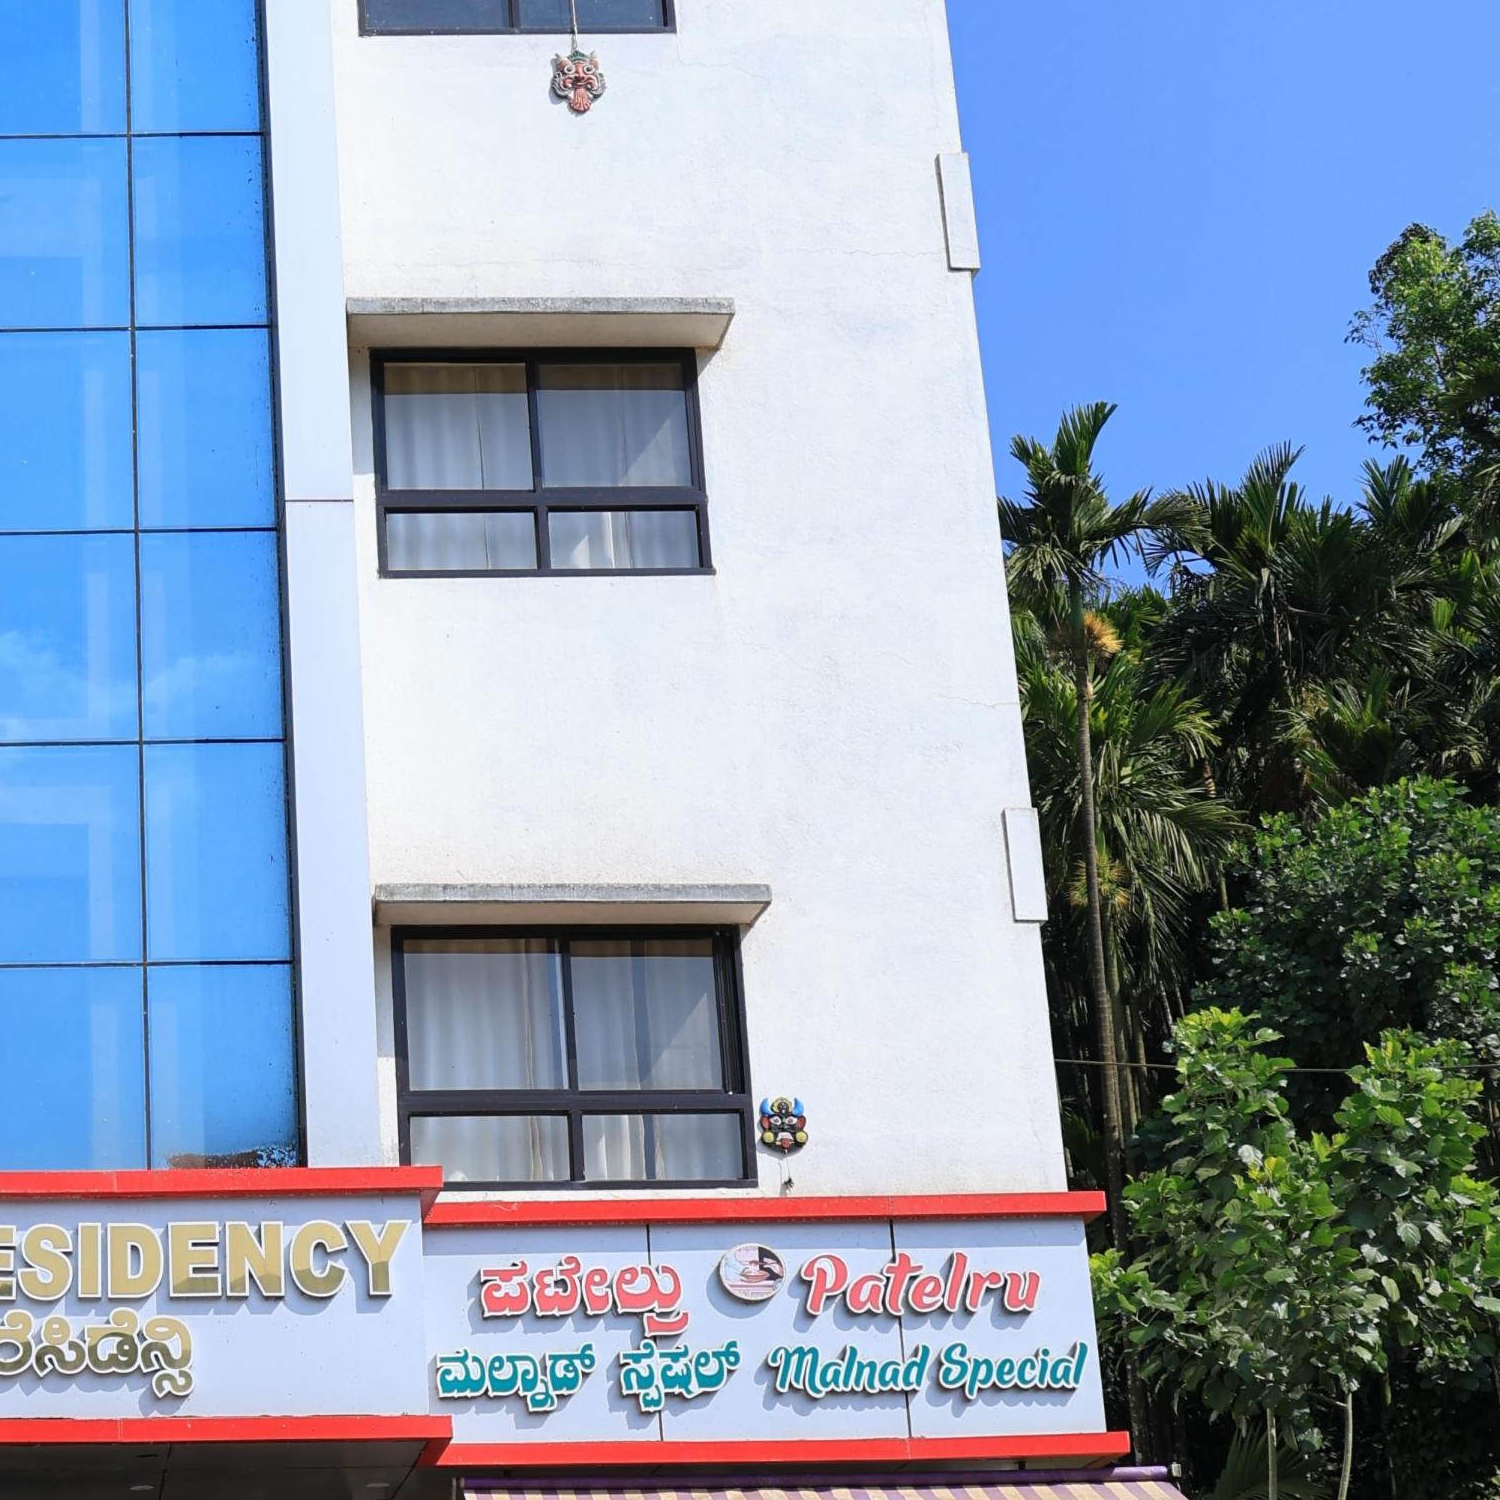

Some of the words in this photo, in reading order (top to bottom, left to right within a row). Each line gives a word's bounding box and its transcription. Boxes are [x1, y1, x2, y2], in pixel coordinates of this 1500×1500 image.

[480, 1254, 690, 1337] ಪಟೇಲ್ರು
[802, 1251, 1041, 1315] Patelru
[436, 1342, 597, 1412] ಮಲ್ನಾಡ್
[619, 1338, 741, 1412] ಸ್ಪೆಷಲ್
[769, 1345, 930, 1398] Malnad
[940, 1342, 1088, 1398] Special
